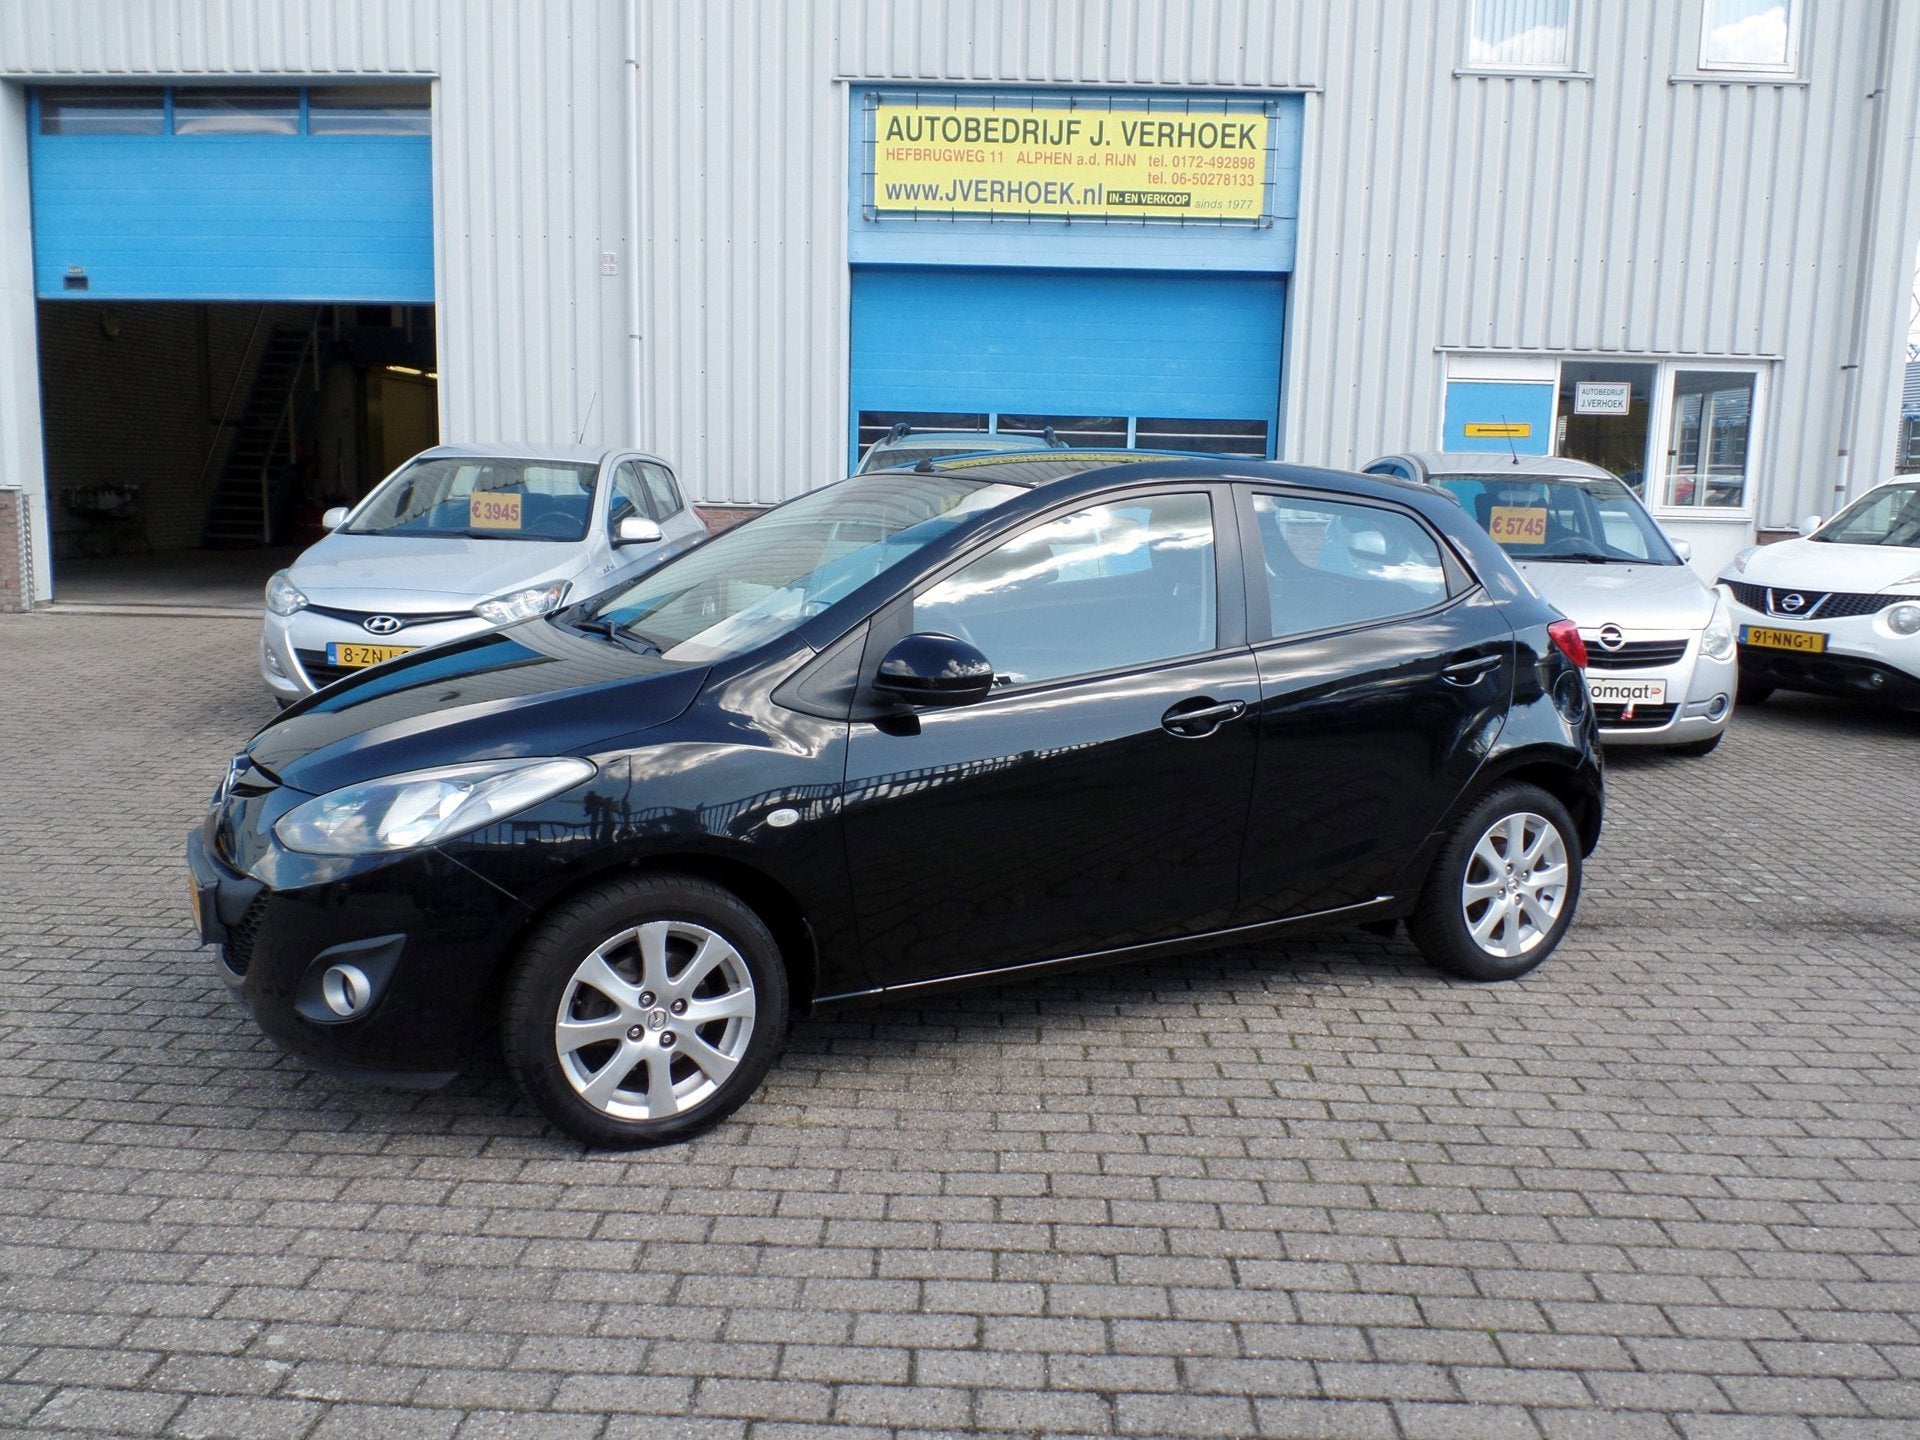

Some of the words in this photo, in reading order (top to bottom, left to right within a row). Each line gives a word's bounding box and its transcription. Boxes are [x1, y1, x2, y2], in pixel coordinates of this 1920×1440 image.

[886, 115, 1081, 146] AUTOBEDRIJF
[1090, 120, 1110, 147] J.
[1121, 121, 1257, 149] VERHOEK
[886, 148, 985, 163] HEFBRUGWEG
[990, 151, 1003, 163] 11
[1016, 151, 1072, 165] ALPHEN
[1076, 153, 1100, 166] a.d.
[1105, 153, 1136, 167] RIJN
[1148, 155, 1168, 168] tel.
[1172, 156, 1255, 170] 0172-492898
[1147, 171, 1166, 184] tel.
[1171, 172, 1255, 187] 06-50278133
[885, 179, 1103, 205] www.JVERHOEK.nl
[1109, 192, 1123, 203] IN-
[1126, 193, 1140, 204] EN
[1140, 194, 1189, 206] VERKOOP
[1194, 199, 1223, 209] sinds
[1227, 199, 1253, 210] 1977
[1581, 388, 1625, 396] AUTOBEDRIJF
[484, 502, 519, 521] 3945
[1506, 517, 1544, 536] 5745
[1753, 630, 1814, 649] 91-NNG-1
[1588, 684, 1649, 699] omaat
